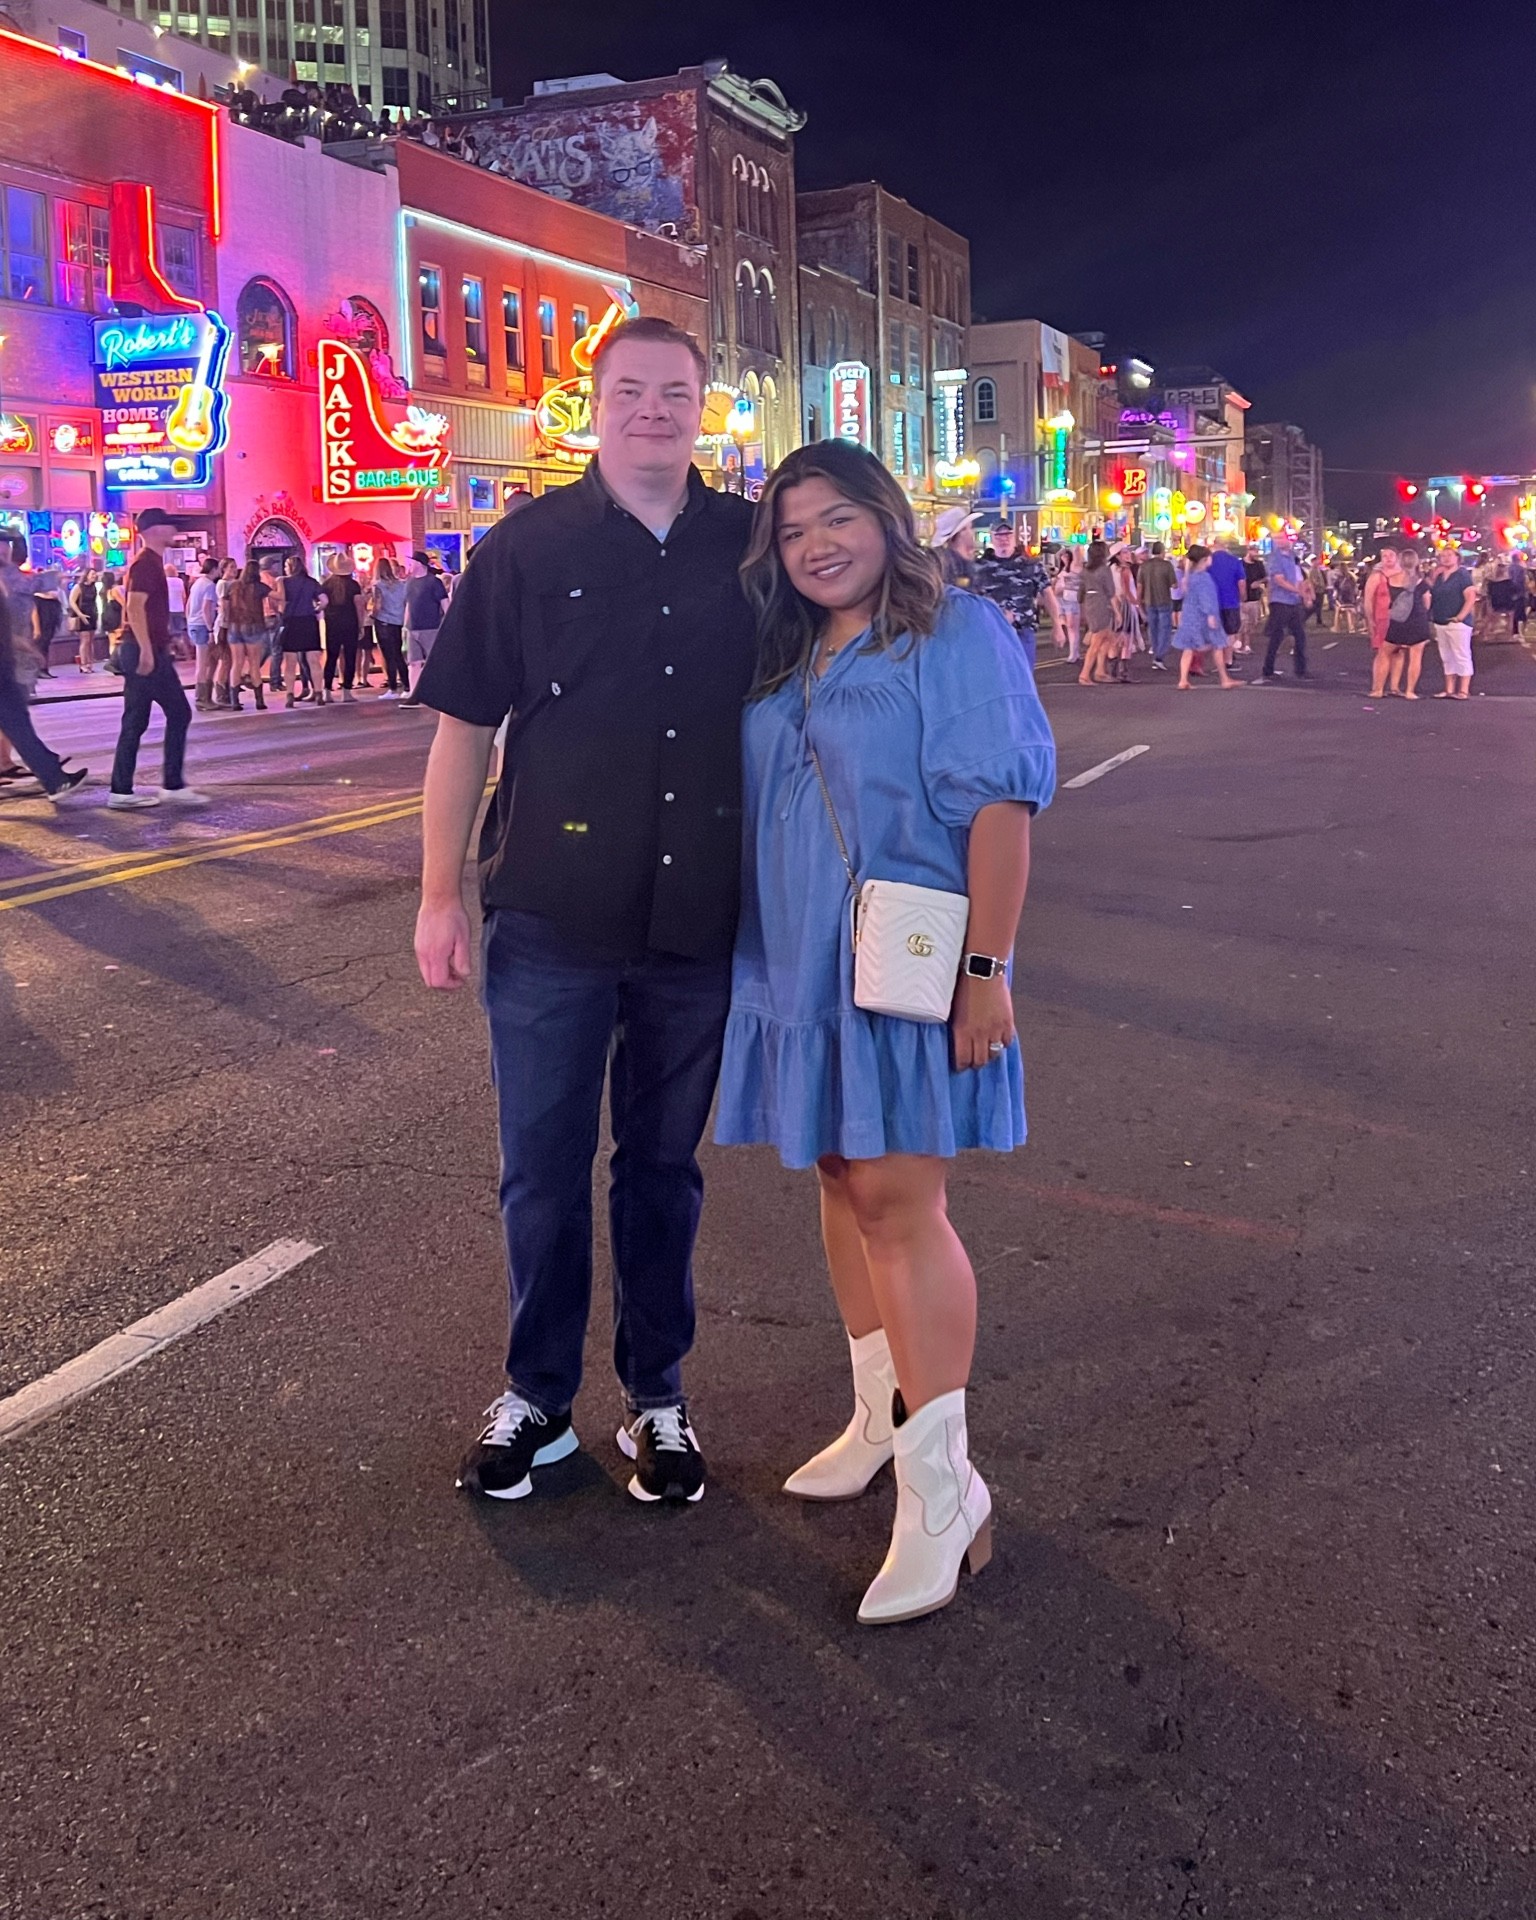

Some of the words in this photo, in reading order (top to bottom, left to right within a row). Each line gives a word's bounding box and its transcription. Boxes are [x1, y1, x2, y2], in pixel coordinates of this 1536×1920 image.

[101, 319, 195, 370] Robert's
[99, 369, 193, 386] WESTERN
[112, 385, 181, 403] WORLD
[102, 407, 158, 423] HOME
[840, 379, 860, 444] SALO
[325, 353, 357, 495] JACKS
[356, 469, 439, 488] BAR-B-QUE
